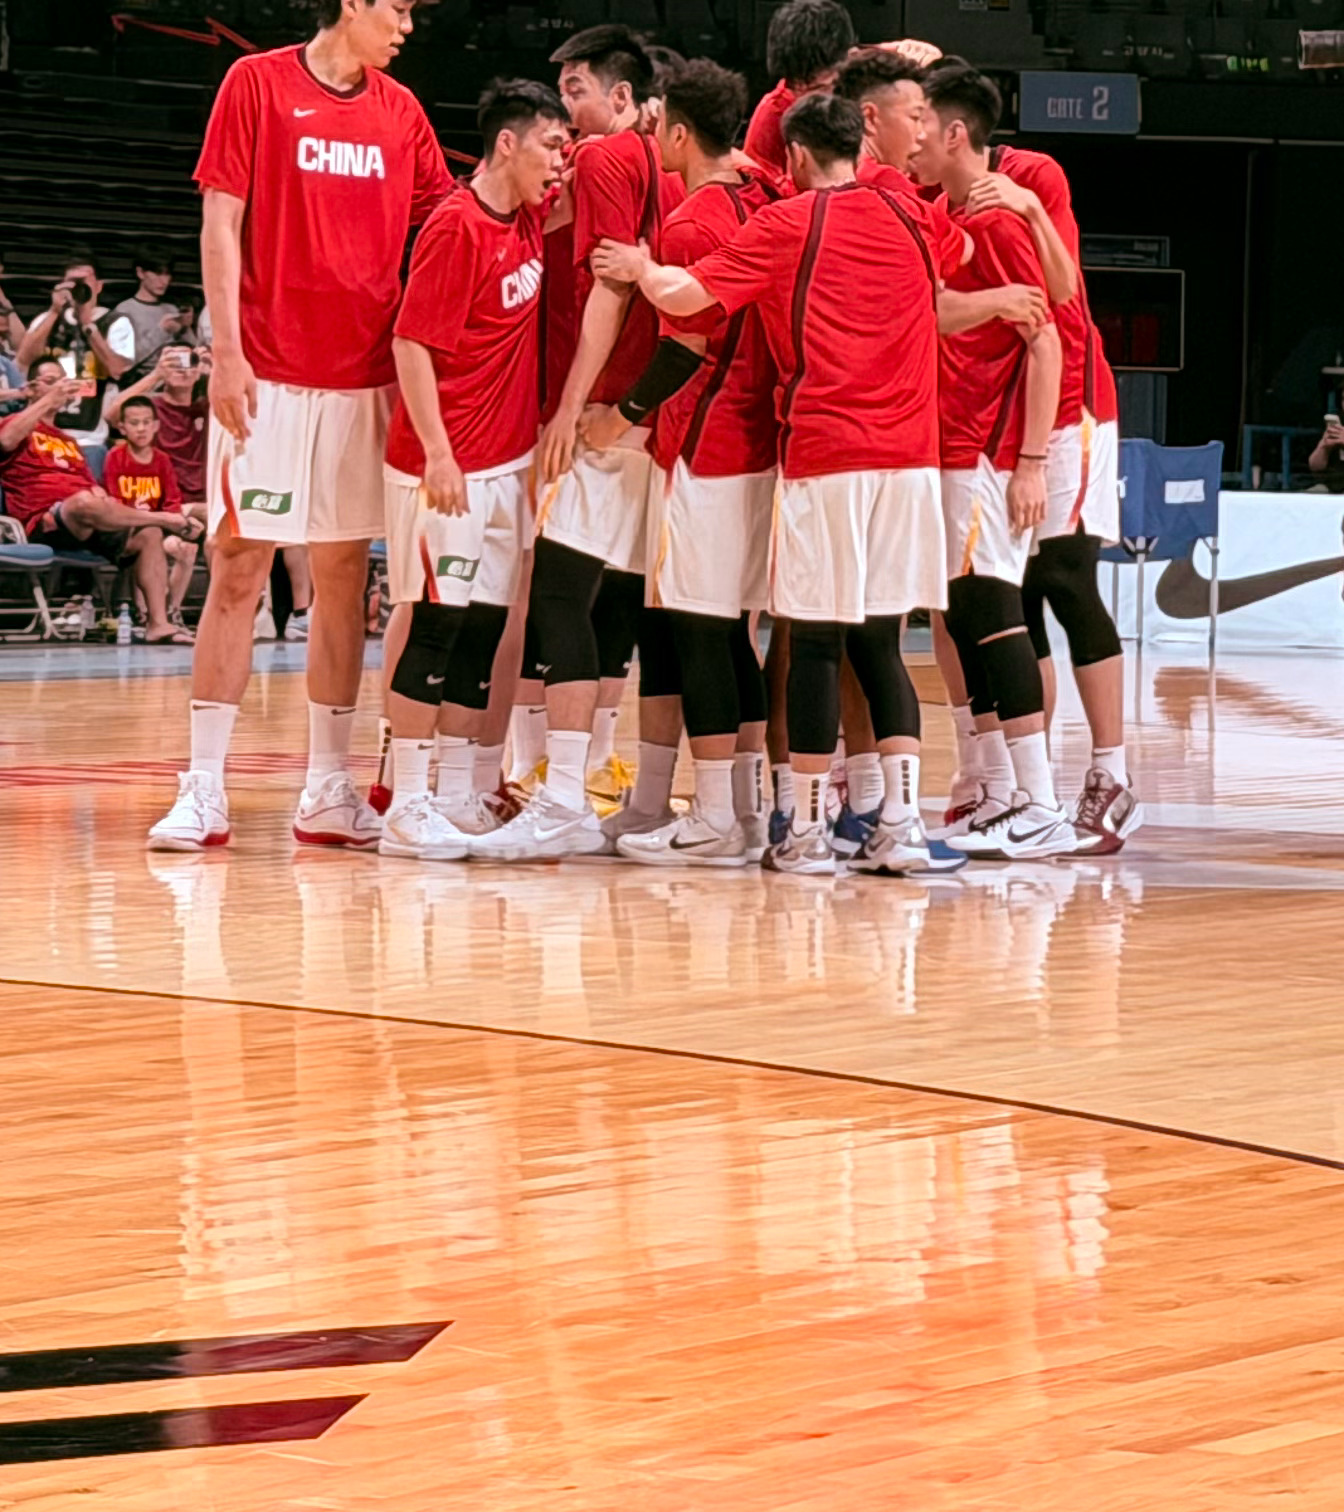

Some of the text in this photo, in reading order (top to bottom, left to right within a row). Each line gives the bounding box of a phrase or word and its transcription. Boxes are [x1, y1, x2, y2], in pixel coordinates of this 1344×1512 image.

[1047, 85, 1110, 121] GATE 2
[297, 136, 385, 180] CHINA
